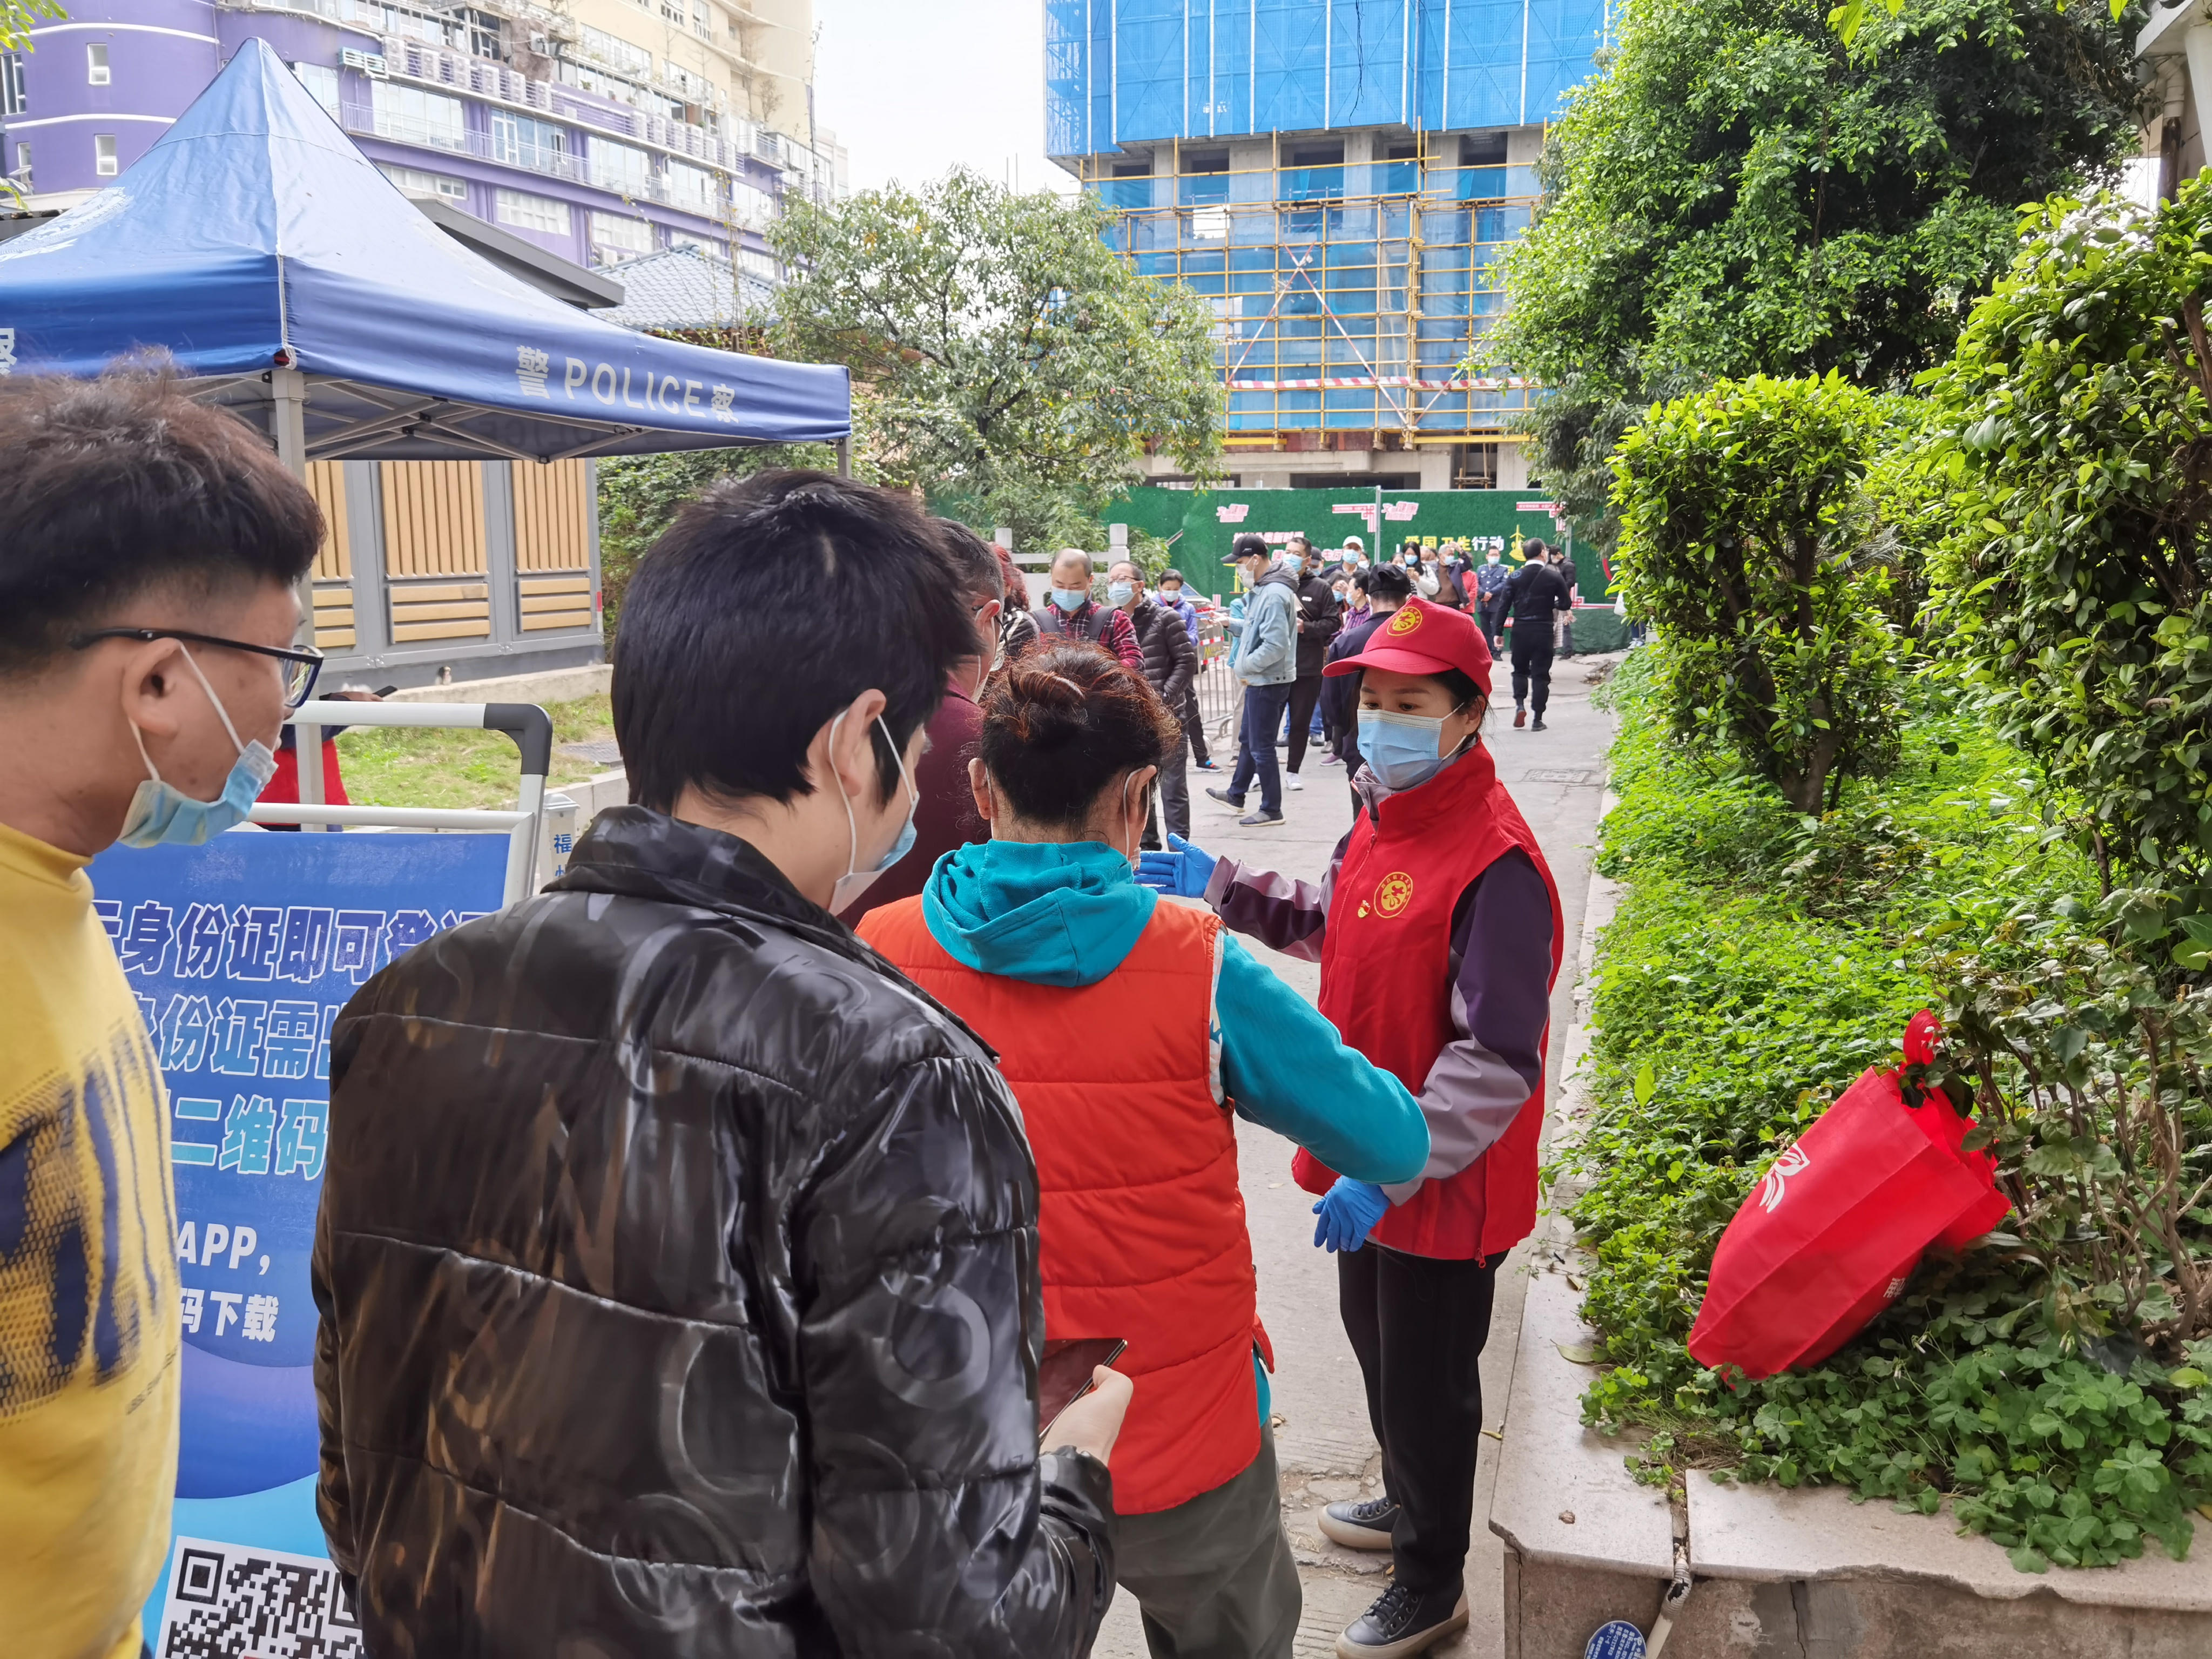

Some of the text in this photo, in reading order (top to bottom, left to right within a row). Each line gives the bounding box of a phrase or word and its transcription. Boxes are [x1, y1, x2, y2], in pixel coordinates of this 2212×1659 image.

[516, 345, 739, 423] 警 POLICE 察
